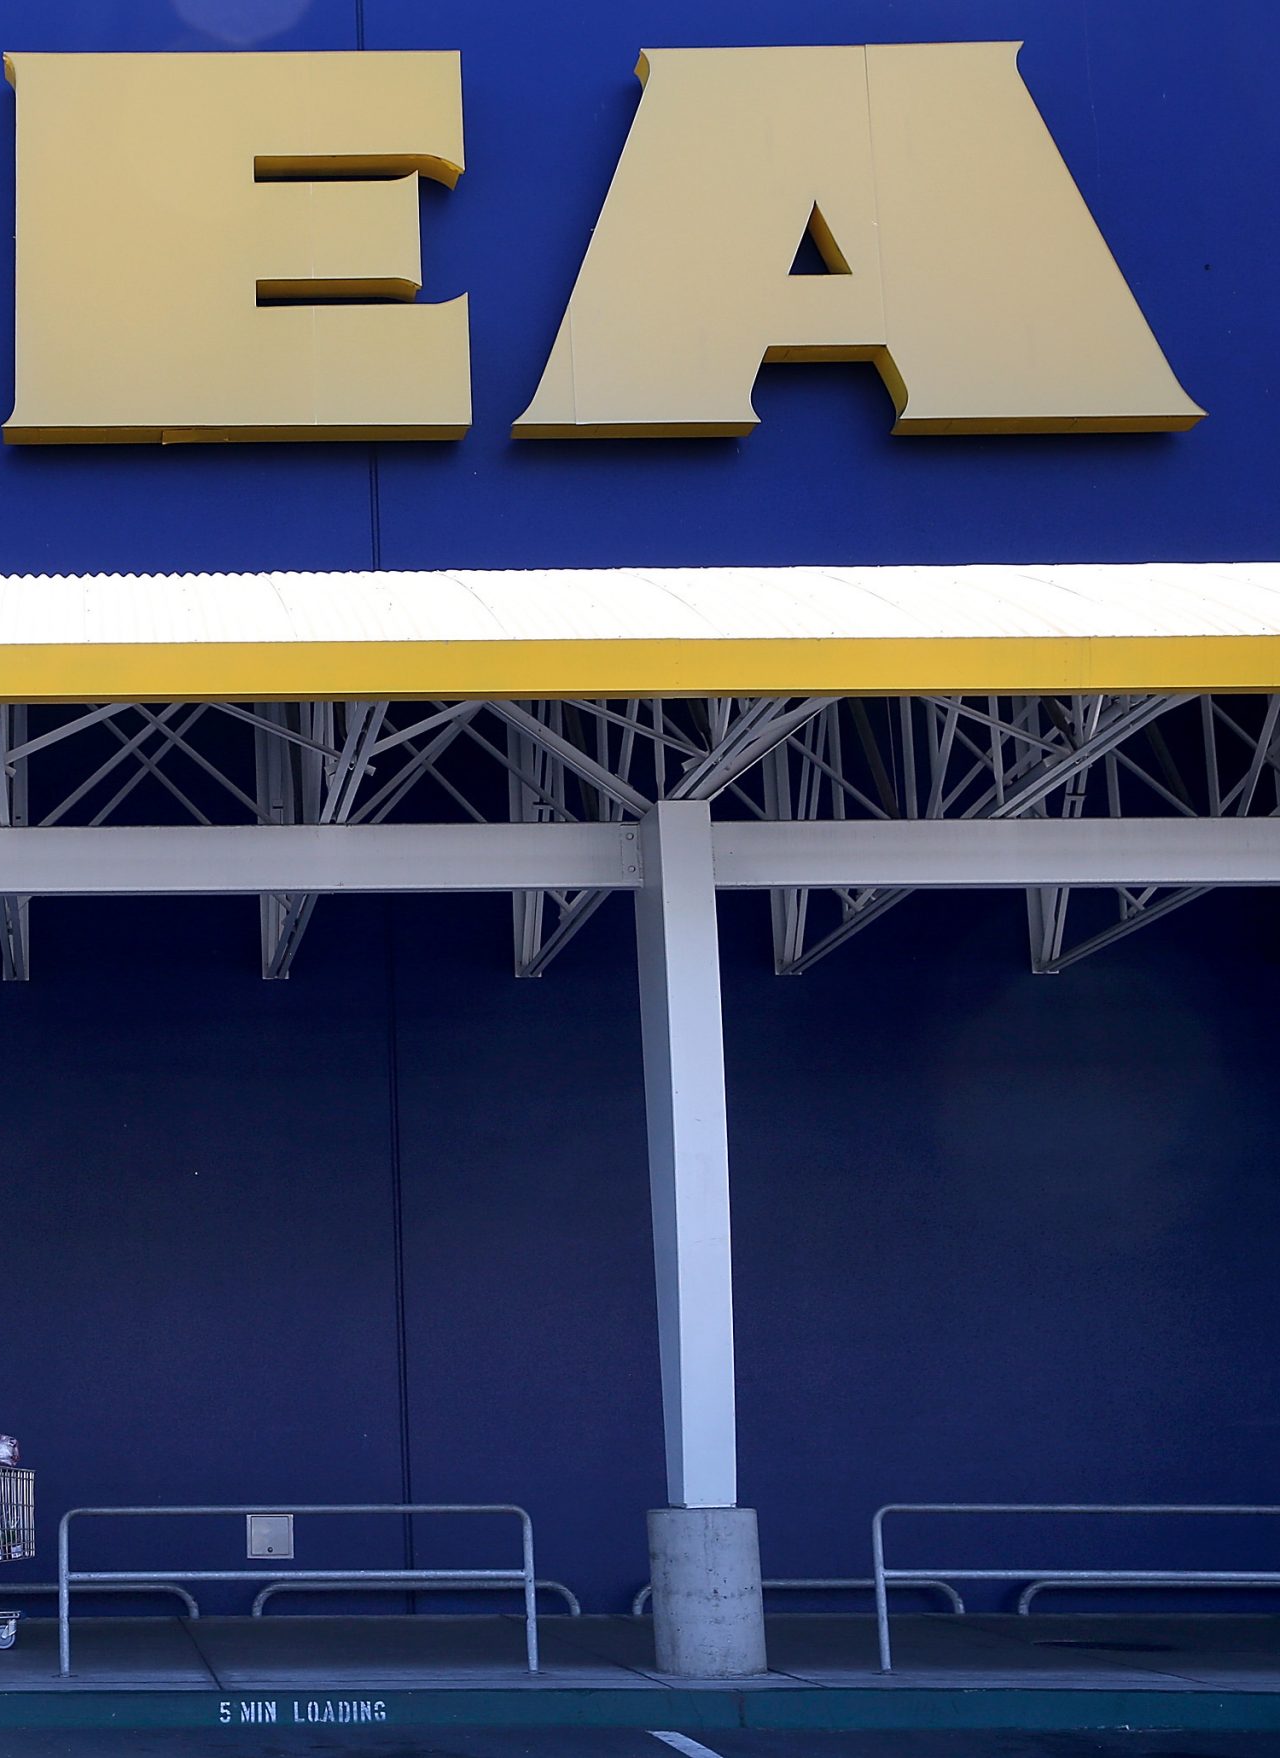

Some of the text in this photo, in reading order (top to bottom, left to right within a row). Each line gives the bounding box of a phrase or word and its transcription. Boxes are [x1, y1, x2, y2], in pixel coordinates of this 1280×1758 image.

[219, 1700, 386, 1723] 5 MIN LOADING
